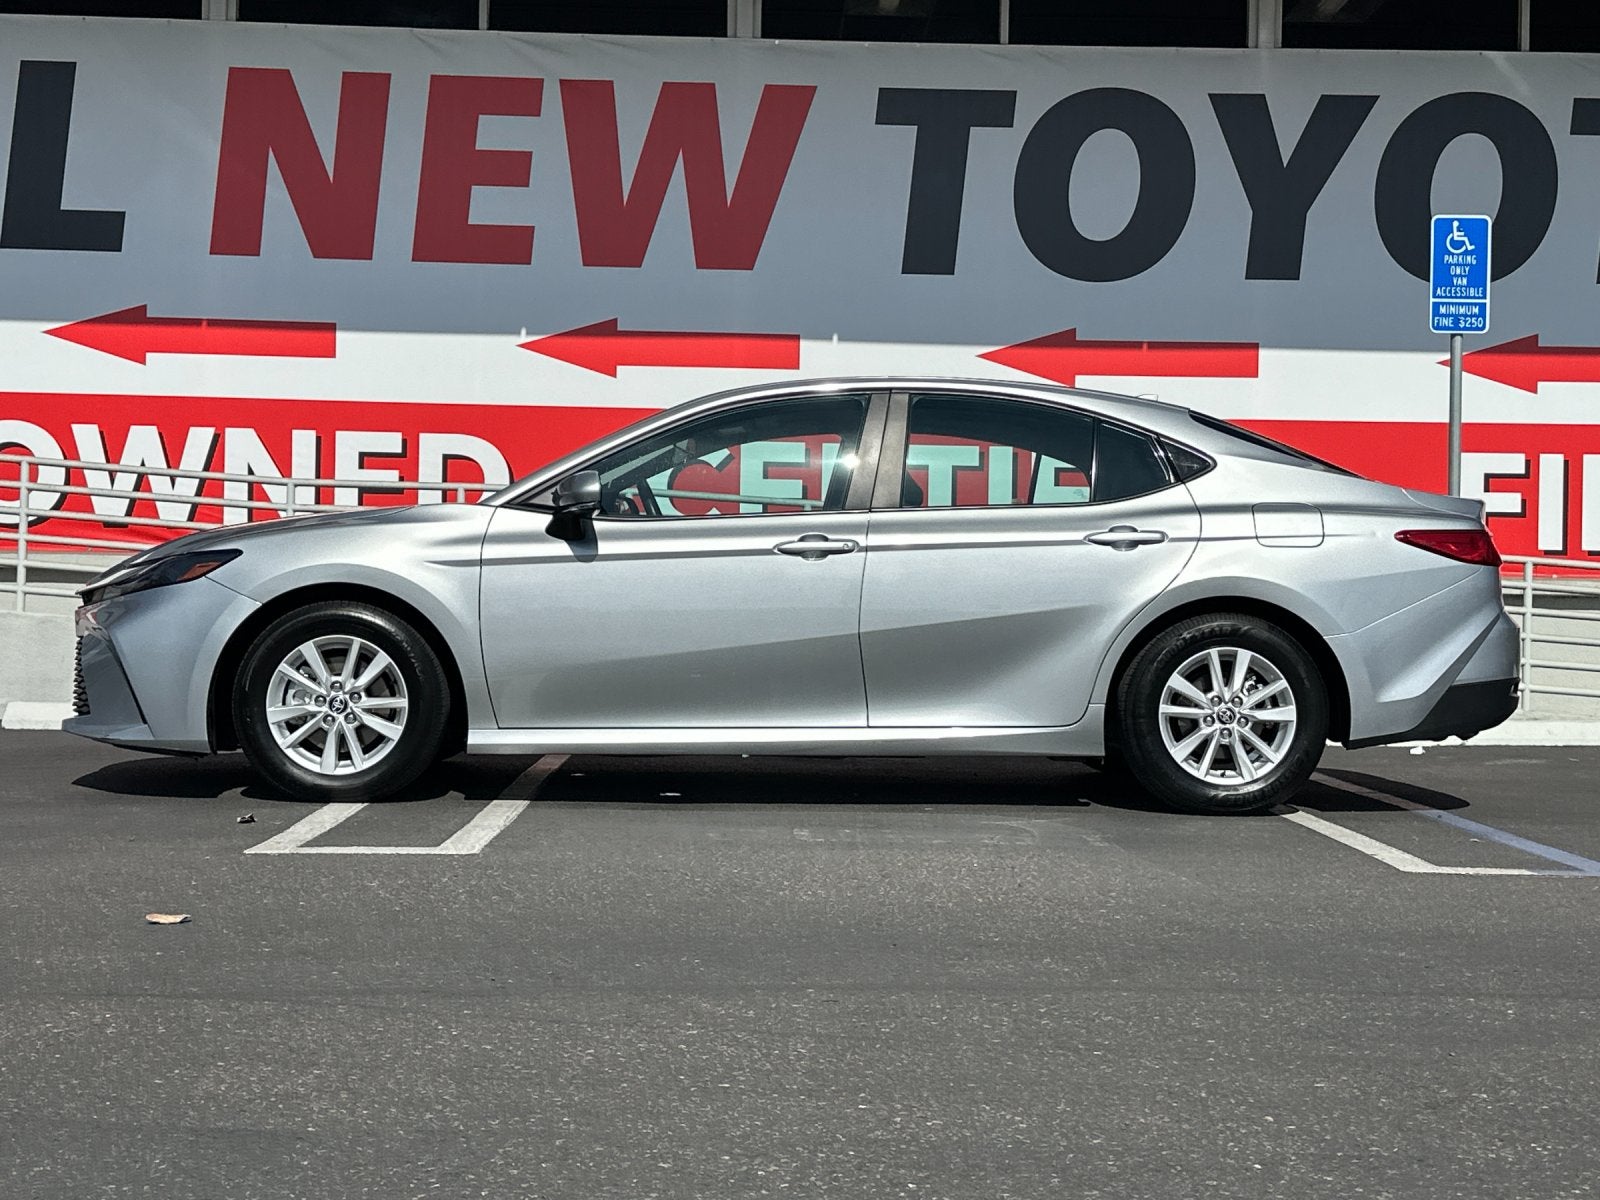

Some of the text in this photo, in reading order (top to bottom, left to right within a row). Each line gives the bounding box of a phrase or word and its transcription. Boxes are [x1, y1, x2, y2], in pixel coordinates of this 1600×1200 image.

[209, 67, 817, 270] NEW
[875, 87, 1600, 283] TOYO
[1443, 254, 1477, 265] PARKING
[1449, 265, 1470, 275] ONLY
[1452, 276, 1468, 286] VAN
[1435, 287, 1484, 297] ACCESSIBLE
[1439, 304, 1479, 315] MINIMUM
[1434, 316, 1484, 328] FINE $250
